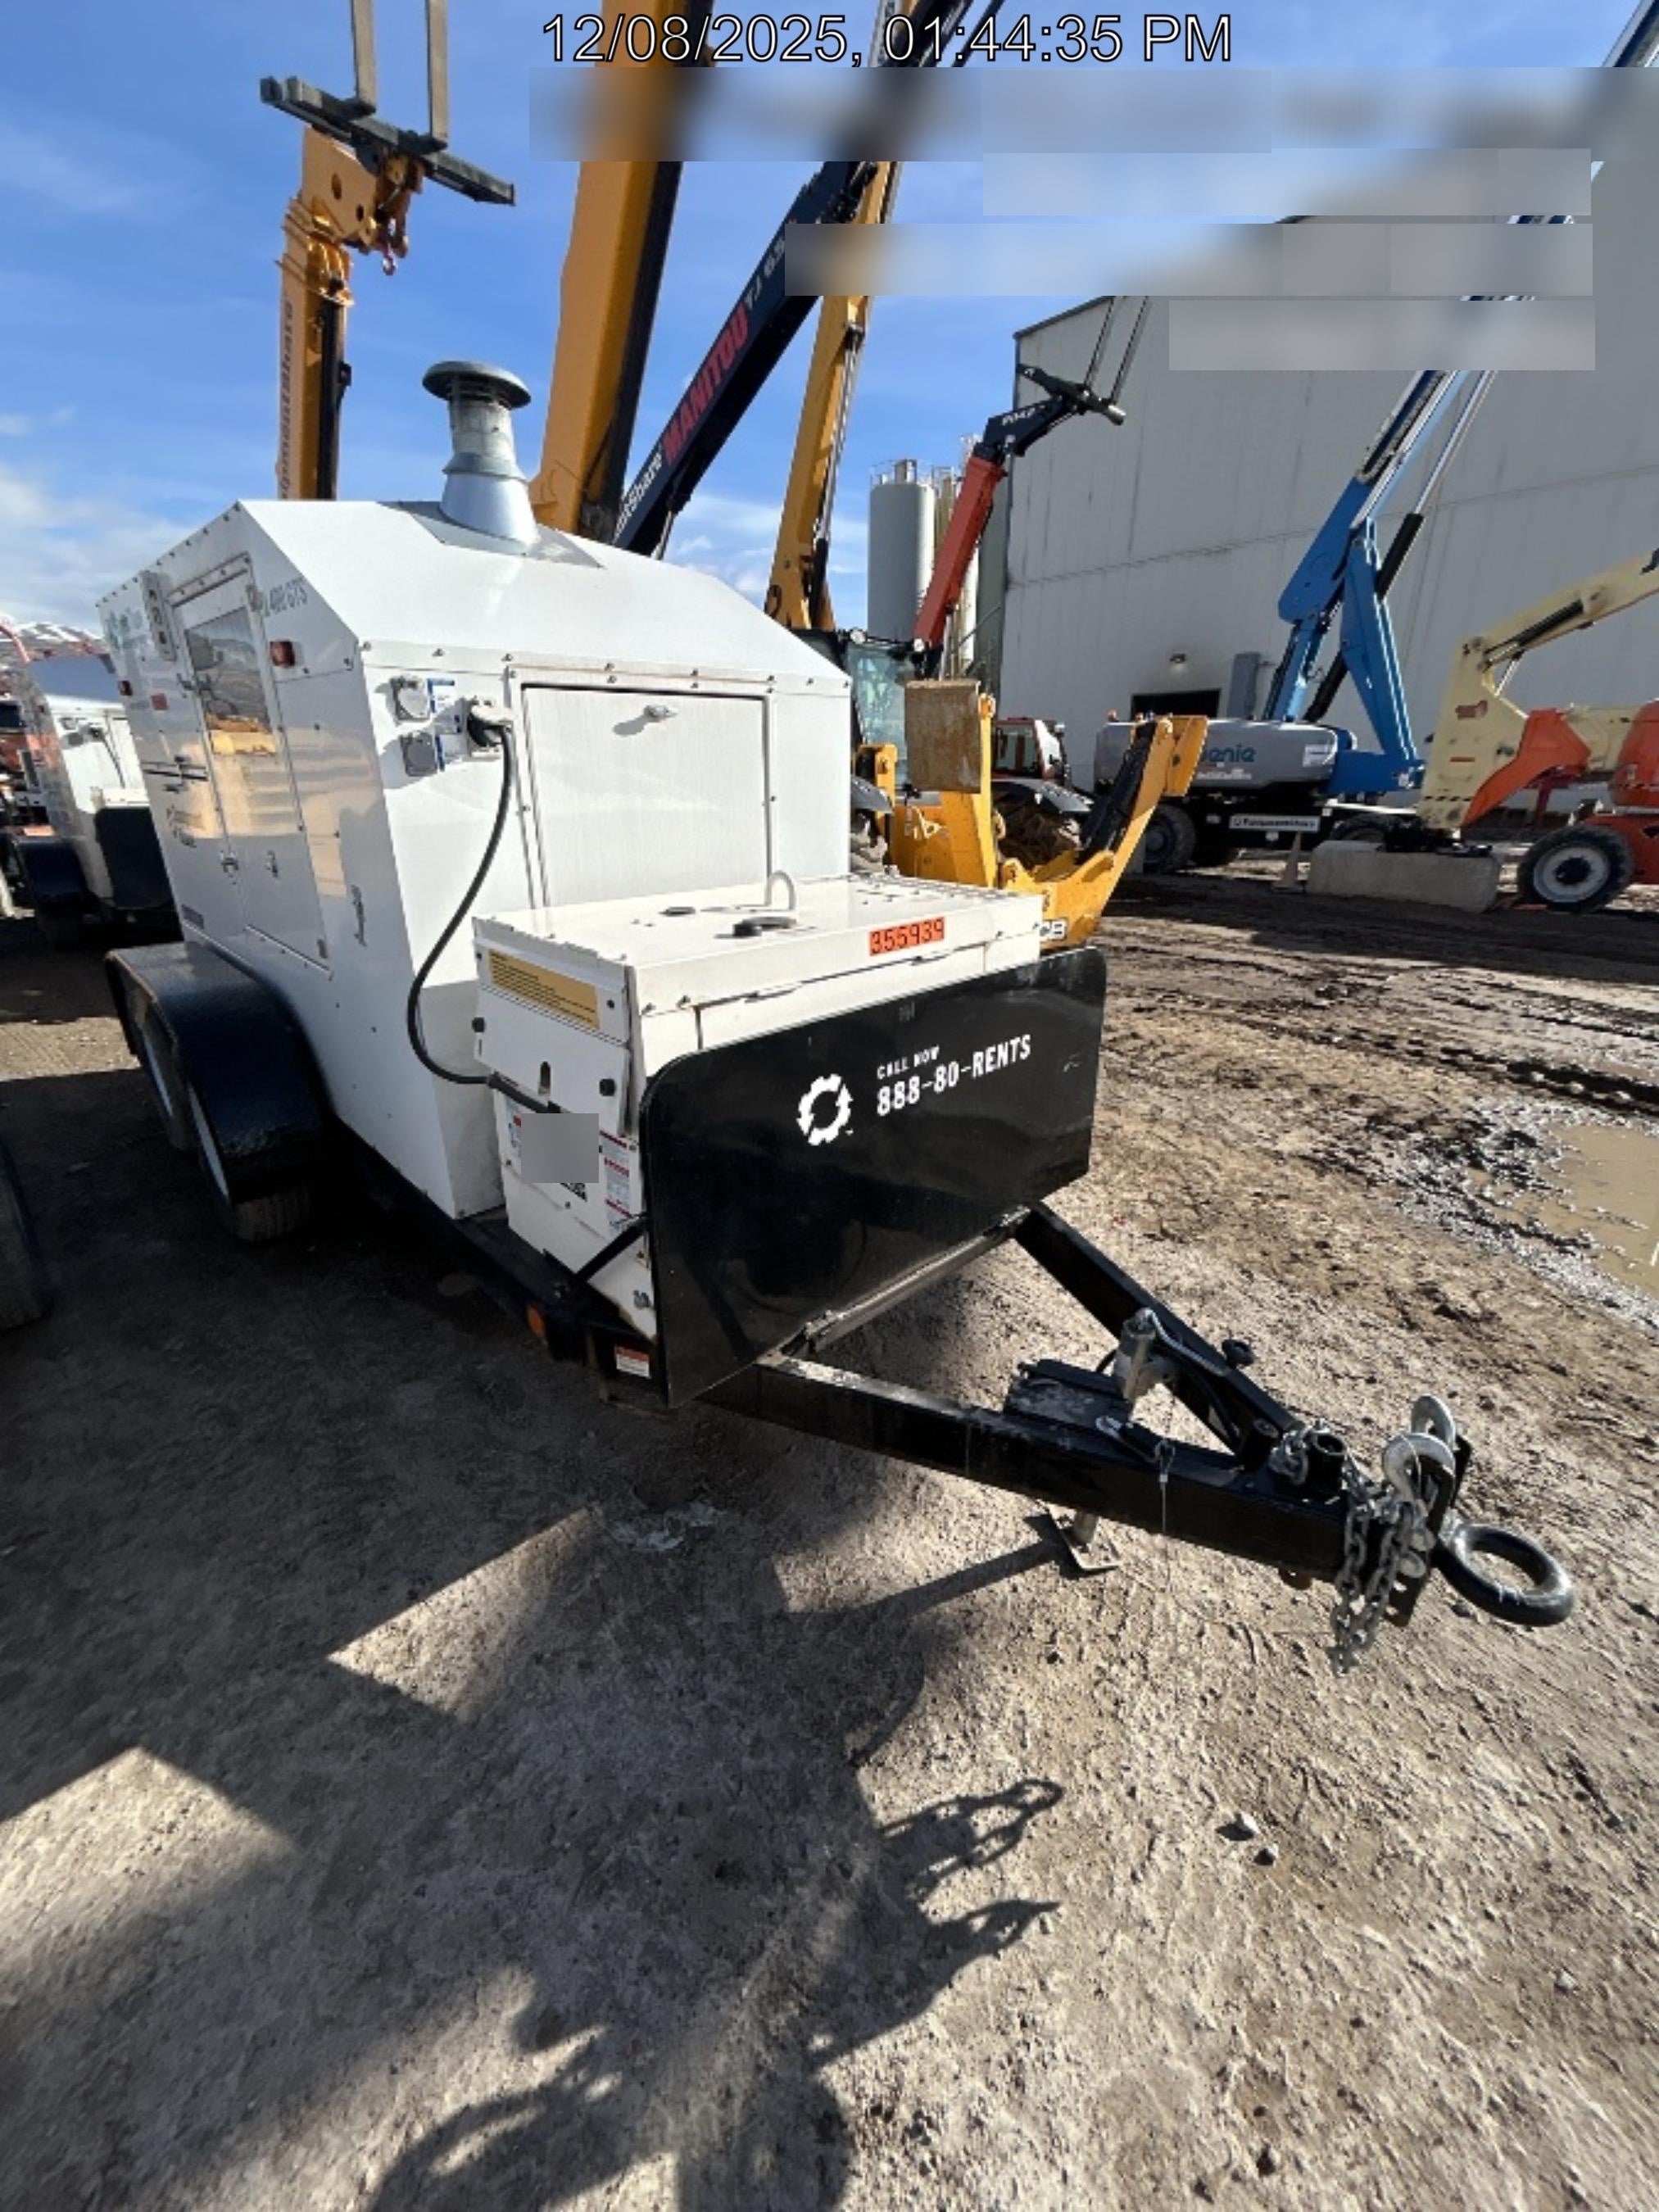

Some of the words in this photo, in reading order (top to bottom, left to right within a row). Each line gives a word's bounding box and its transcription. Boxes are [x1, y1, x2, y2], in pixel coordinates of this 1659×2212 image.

[662, 302, 749, 465] MANITOU
[1201, 743, 1257, 763] enie
[869, 918, 945, 955] 355939
[876, 1056, 909, 1080] CALL
[913, 1045, 940, 1067] NOW
[877, 1034, 1031, 1117] 888-80-RENTS
